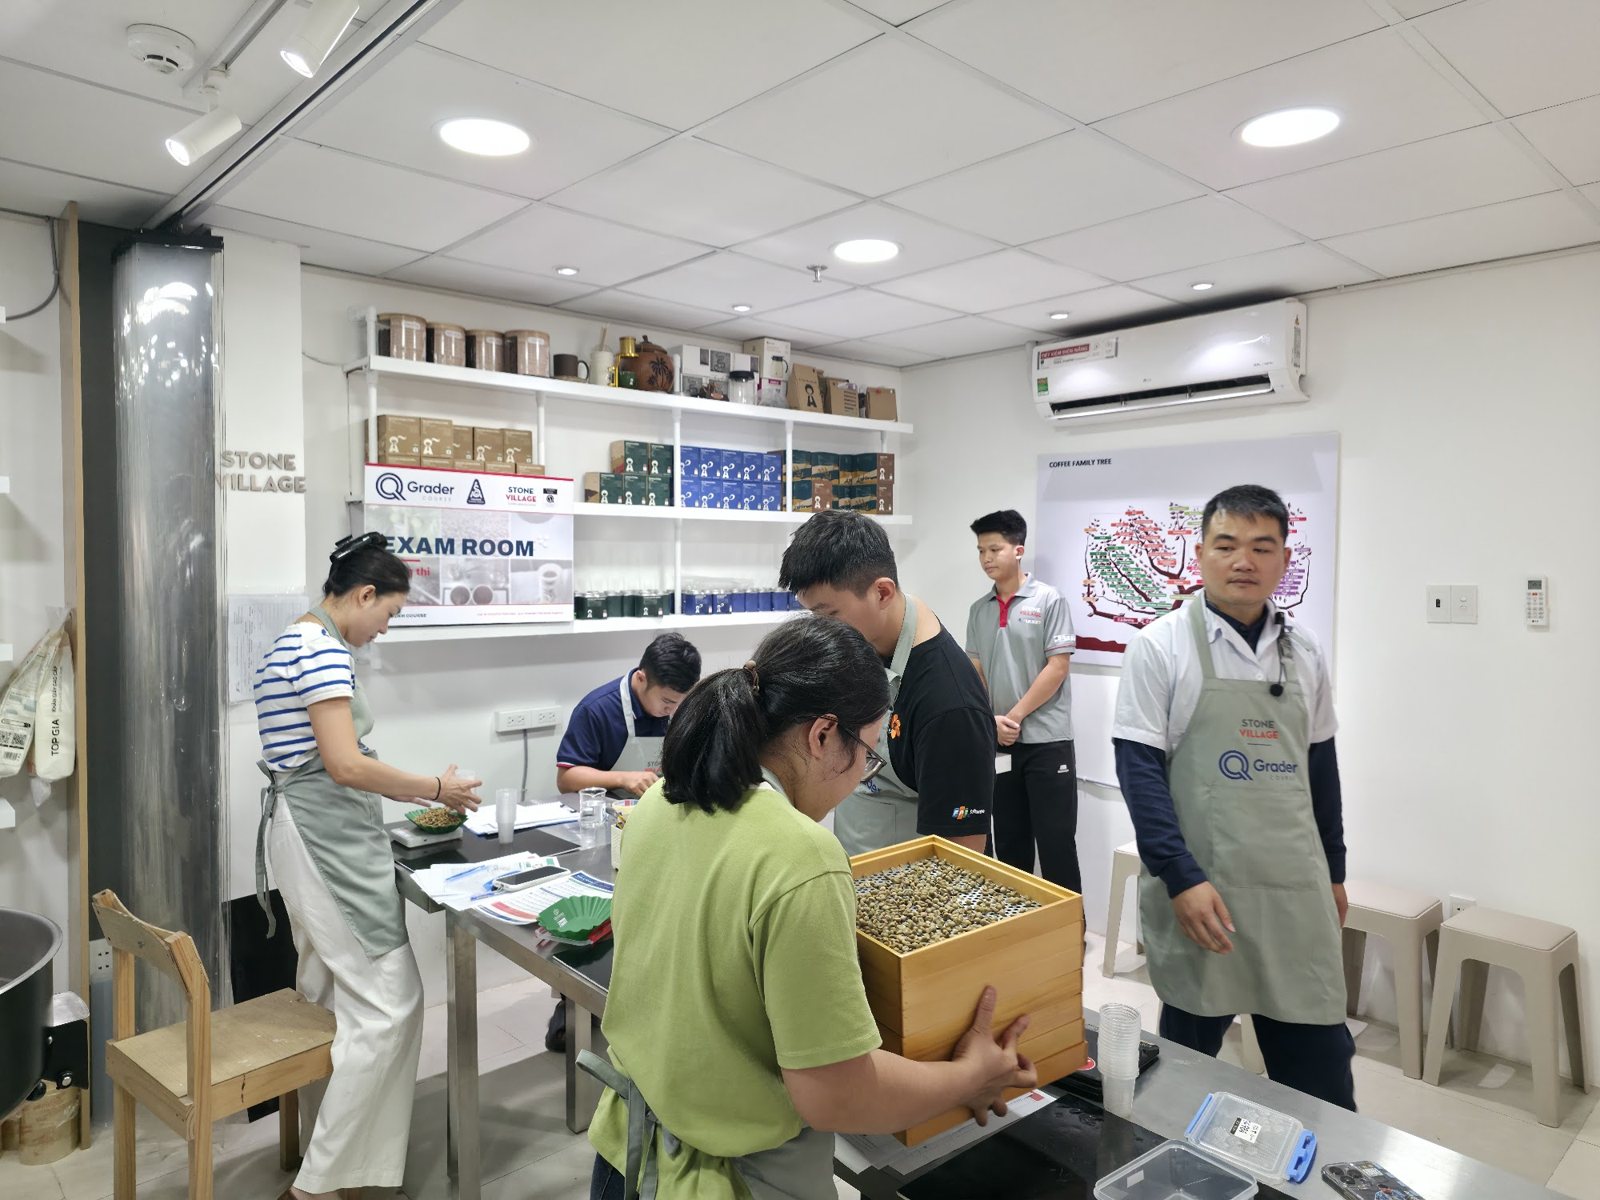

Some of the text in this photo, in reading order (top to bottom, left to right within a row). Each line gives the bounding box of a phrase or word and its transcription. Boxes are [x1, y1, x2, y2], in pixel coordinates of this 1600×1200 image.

[221, 450, 296, 471] STONE
[1072, 459, 1095, 467] FAMILY
[215, 473, 306, 493] VILLAGE
[407, 481, 455, 495] Grader
[508, 486, 534, 494] STONE
[505, 494, 537, 503] VILLAGE
[384, 536, 534, 557] EXAM ROOM
[416, 567, 430, 577] thi
[1241, 719, 1274, 728] STONE
[1239, 729, 1279, 739] VILLAGE
[51, 738, 59, 757] TOP
[1253, 759, 1298, 773] Grader
